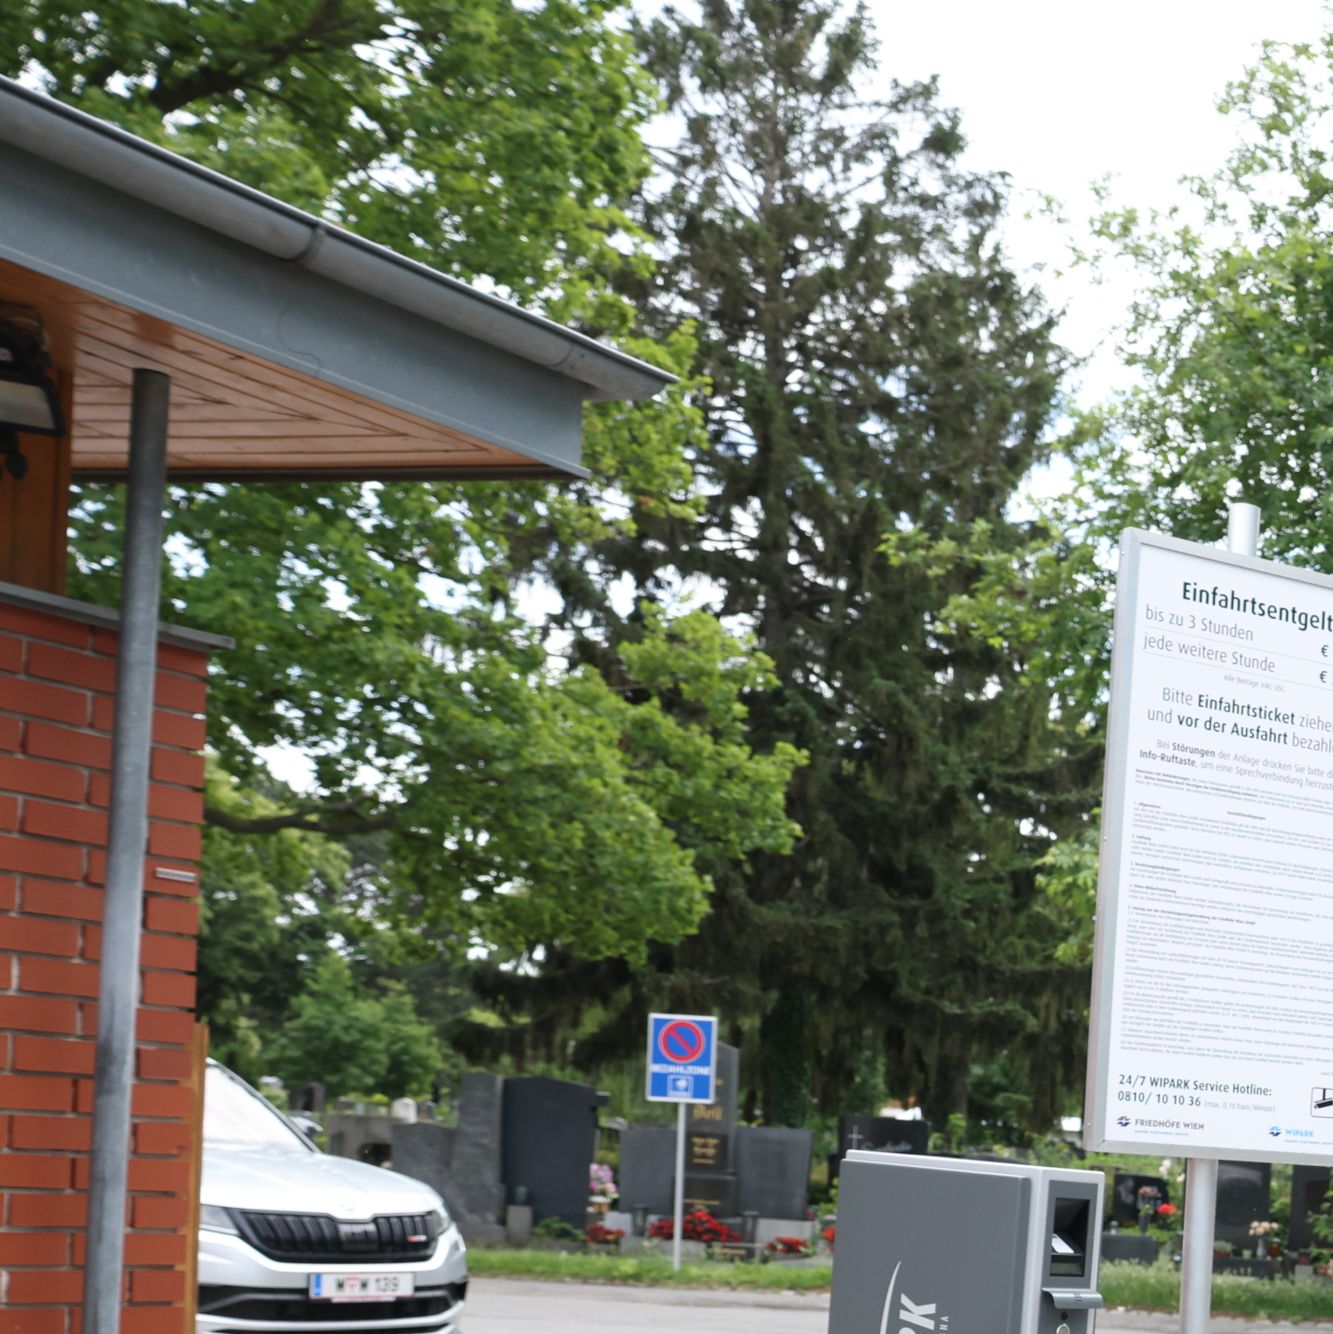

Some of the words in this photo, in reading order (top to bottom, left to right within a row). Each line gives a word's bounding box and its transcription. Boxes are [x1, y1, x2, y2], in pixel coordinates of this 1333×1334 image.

[1182, 581, 1333, 632] Einfahrtsentgelt
[1145, 604, 1164, 622] bis
[1169, 613, 1184, 627] zu
[1188, 614, 1197, 629] 3
[1201, 617, 1254, 641] Stunden
[1321, 644, 1329, 657] €
[1143, 632, 1173, 652] jede
[1178, 642, 1227, 663] weitere
[1231, 651, 1275, 673] Stunde
[1320, 670, 1328, 683] €
[1162, 687, 1193, 706] Bitte
[1198, 694, 1295, 725] Einfahrtsticket
[1147, 708, 1173, 724] und
[1178, 714, 1199, 728] vor
[1204, 716, 1226, 733] der
[1230, 722, 1288, 745] Ausfahrt
[1139, 749, 1198, 768] Info-Ruftaste,
[1200, 761, 1214, 770] um
[1216, 763, 1233, 773] eine
[1235, 766, 1304, 788] Sprechverbindung
[1156, 739, 1170, 750] Bei
[1172, 742, 1215, 758] Störungen
[1217, 750, 1231, 760] der
[1233, 753, 1260, 767] Anlage
[1294, 764, 1306, 774] Sie
[1307, 767, 1325, 778] bitte
[1118, 1090, 1152, 1105] 0810/
[1156, 1093, 1169, 1104] 10
[1173, 1095, 1185, 1106] 10
[1188, 1095, 1201, 1107] 36
[1119, 1074, 1146, 1088] 24/7
[1149, 1077, 1190, 1090] WIPARK
[1193, 1080, 1230, 1093] Service
[1232, 1083, 1272, 1096] Hotline:
[1135, 1118, 1181, 1129] FRIEDHÖFE
[1183, 1121, 1205, 1130] WIEN
[1285, 1128, 1315, 1137] WIPARK
